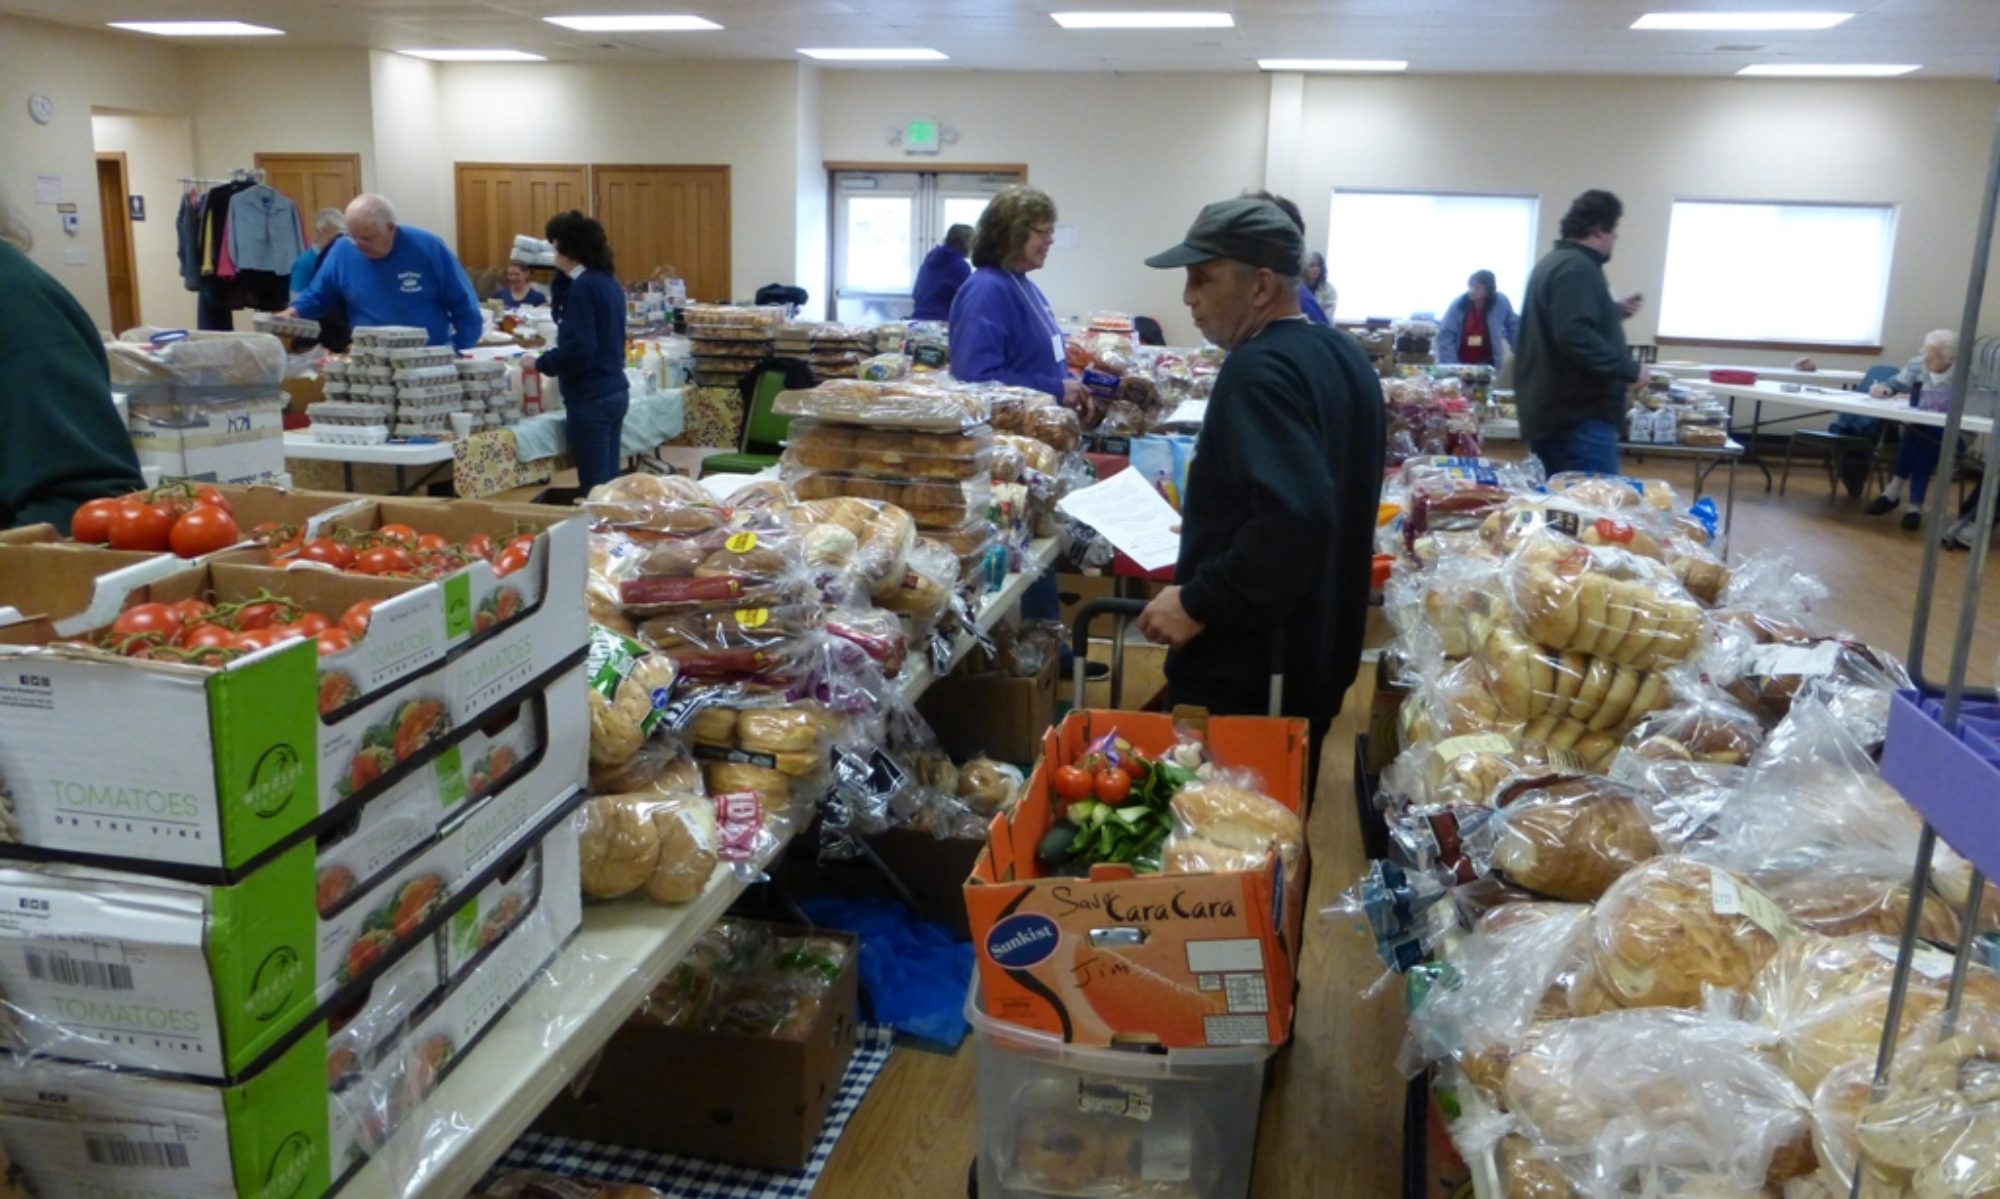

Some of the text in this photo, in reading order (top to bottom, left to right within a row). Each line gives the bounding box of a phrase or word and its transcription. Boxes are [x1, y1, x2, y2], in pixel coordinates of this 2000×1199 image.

[50, 779, 200, 818] TOMATOES
[151, 825, 202, 840] VINE
[1052, 885, 1110, 917] Save
[1104, 890, 1237, 923] Cara Cara
[990, 925, 1055, 960] Sunkist
[1071, 957, 1130, 988] Jim
[51, 995, 200, 1032] TOMATOES
